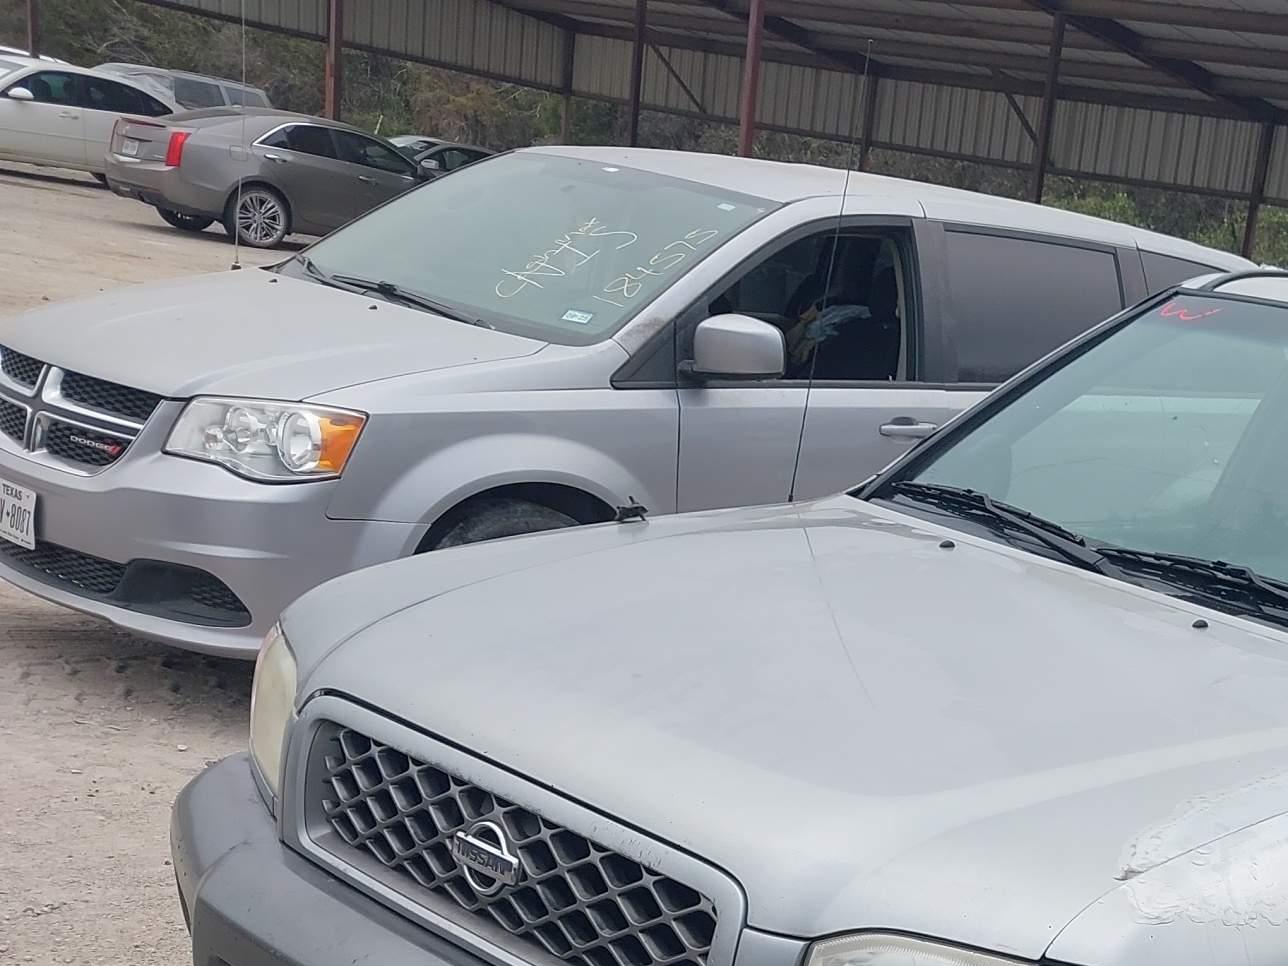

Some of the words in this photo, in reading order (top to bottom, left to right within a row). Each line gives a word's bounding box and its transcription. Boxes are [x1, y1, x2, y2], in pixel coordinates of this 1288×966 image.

[70, 435, 112, 451] DODGE
[2, 483, 22, 500] TEXAS
[454, 837, 504, 876] NISSAN
